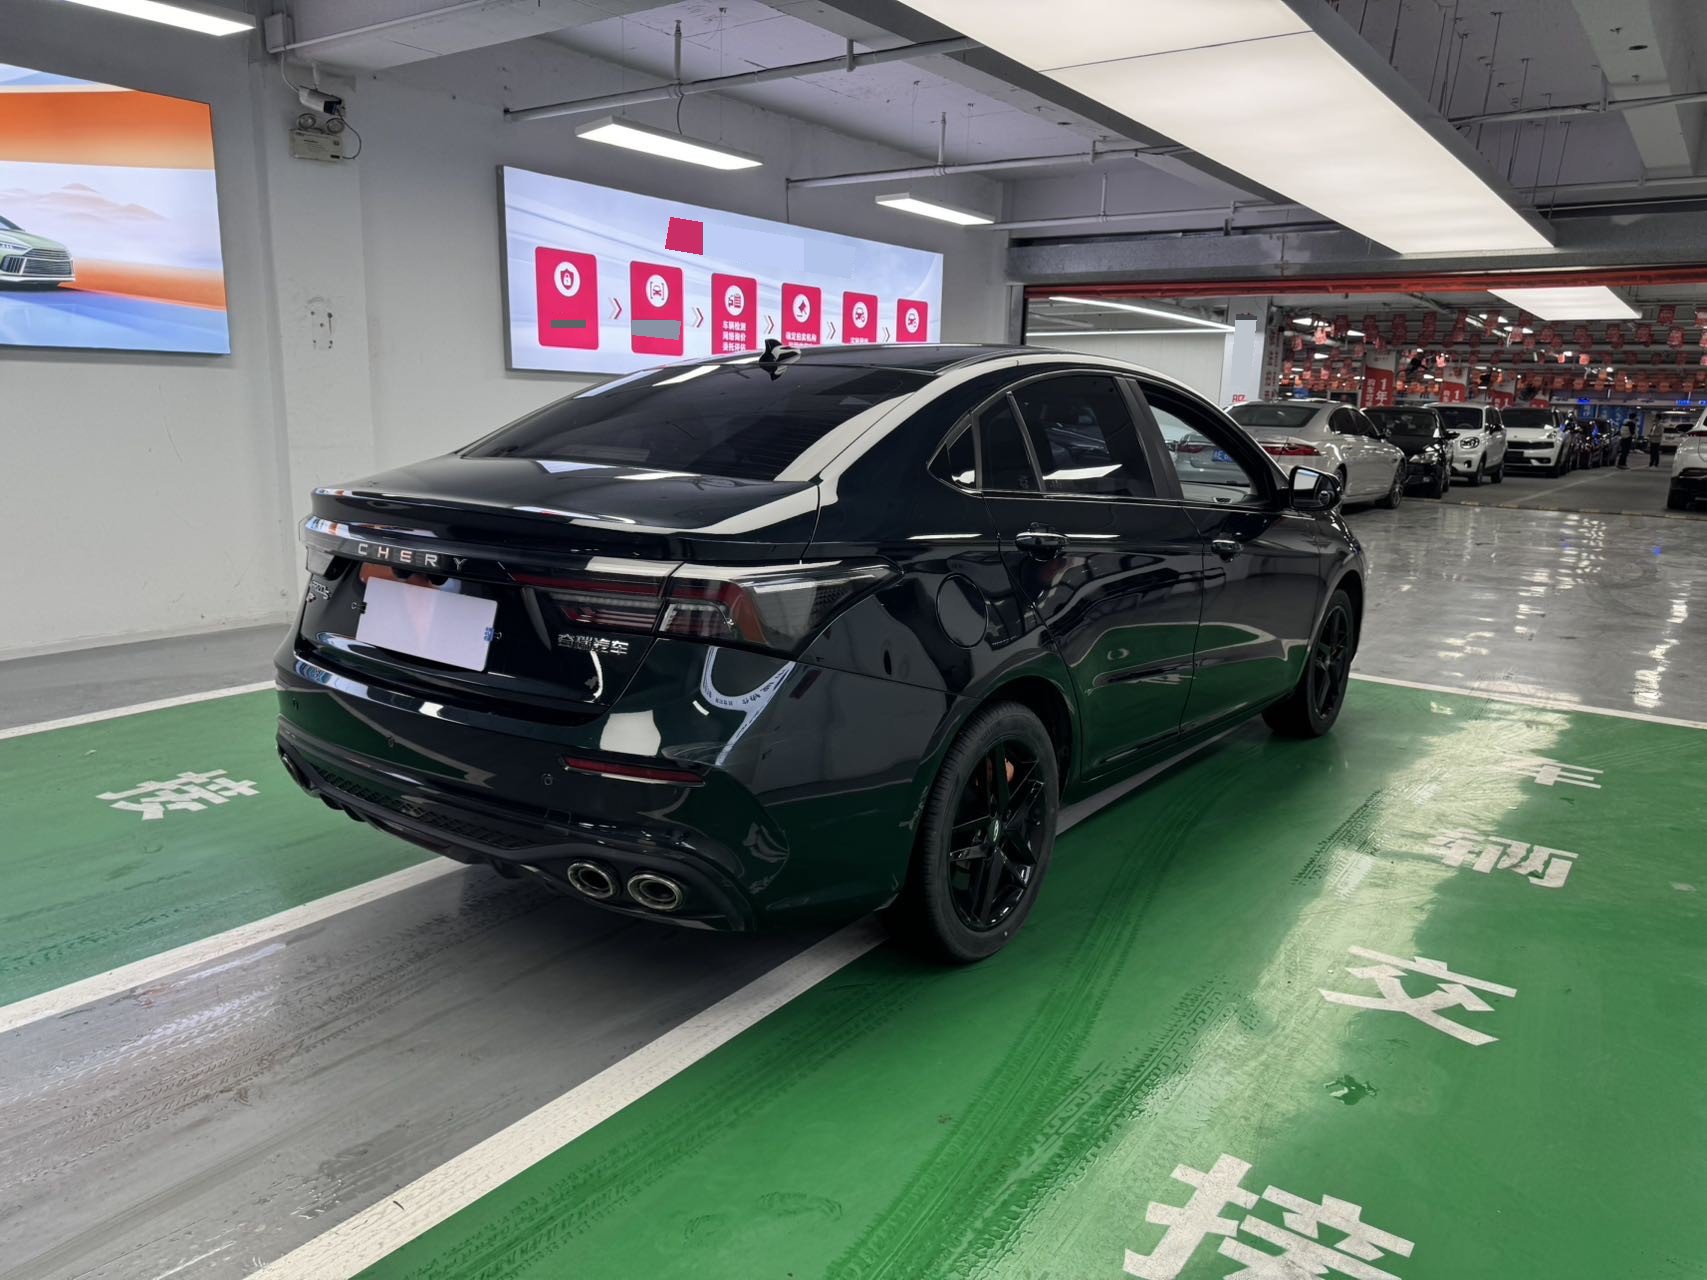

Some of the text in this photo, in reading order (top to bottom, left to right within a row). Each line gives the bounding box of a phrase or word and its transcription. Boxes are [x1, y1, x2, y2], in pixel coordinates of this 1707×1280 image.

[722, 320, 747, 332] 车辆检测
[722, 331, 747, 342] 网络询价
[357, 542, 467, 573] CHERY
[557, 633, 630, 656] 奇瑞汽车
